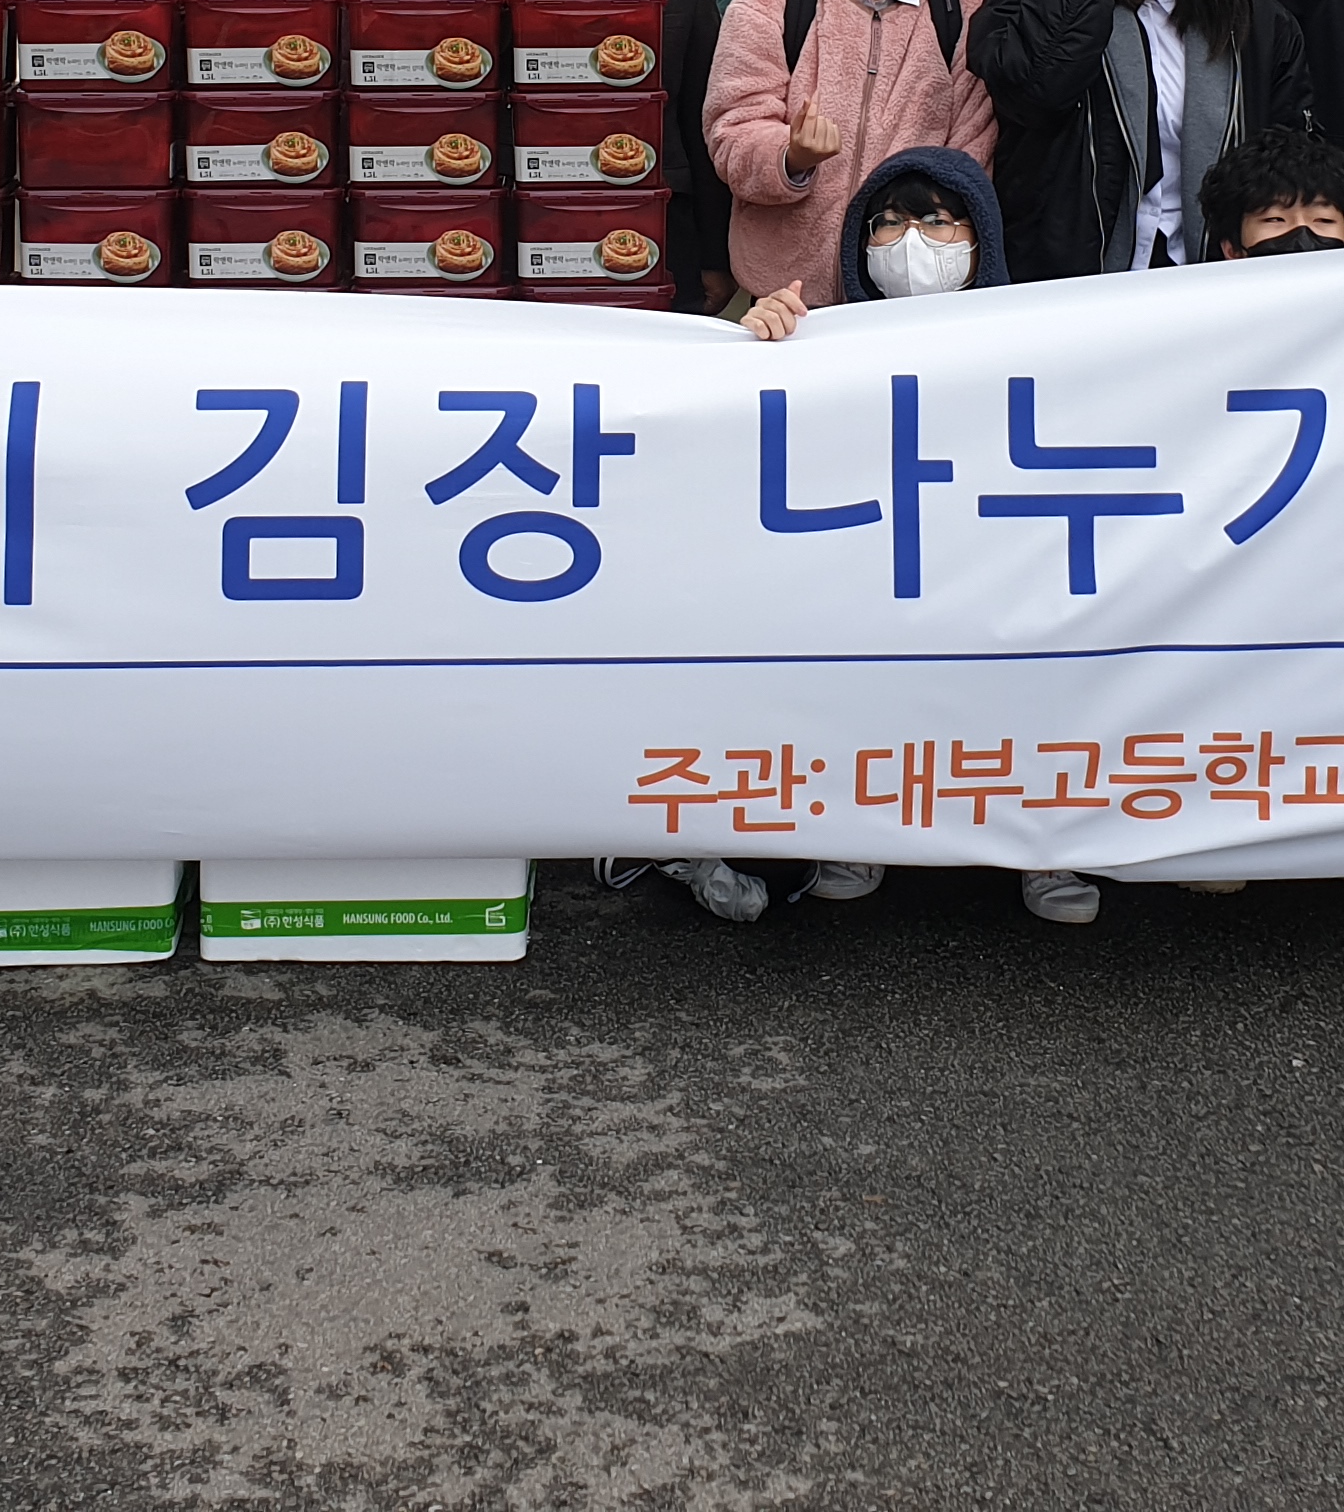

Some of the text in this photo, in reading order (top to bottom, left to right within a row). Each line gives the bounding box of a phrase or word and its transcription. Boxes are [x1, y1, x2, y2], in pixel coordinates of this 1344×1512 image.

[185, 381, 635, 602] 김장
[628, 744, 825, 833] 주관:
[90, 920, 137, 932] HANSUNG
[138, 919, 162, 931] FOOD
[342, 913, 388, 925] HANSUNG
[391, 912, 415, 924] FOOD
[435, 911, 453, 924] Ltd.
